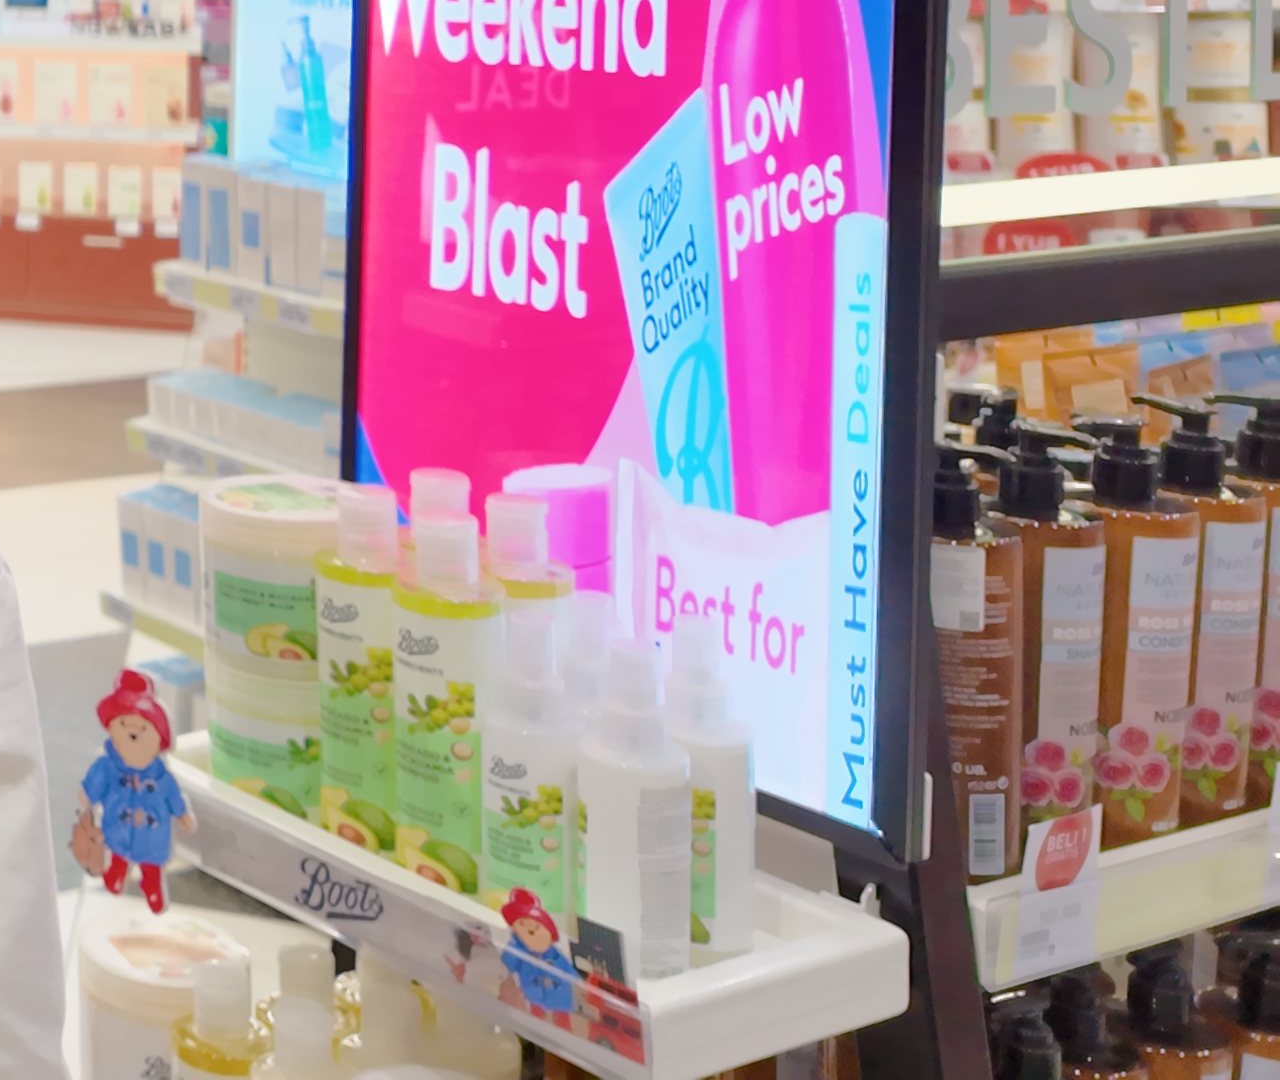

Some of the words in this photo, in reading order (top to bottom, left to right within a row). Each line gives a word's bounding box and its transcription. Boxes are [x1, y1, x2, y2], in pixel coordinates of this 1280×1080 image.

[720, 77, 804, 167] Low
[428, 141, 589, 319] Blast
[639, 161, 683, 262] Boots
[724, 153, 846, 281] prices
[641, 223, 698, 311] Brand
[641, 271, 710, 354] Quality
[847, 270, 872, 444] Deals
[844, 467, 869, 632] Have
[398, 627, 439, 655] Boots
[748, 581, 806, 676] for
[842, 654, 868, 810] Must
[294, 857, 384, 921] Boots
[1046, 831, 1078, 852] BELI
